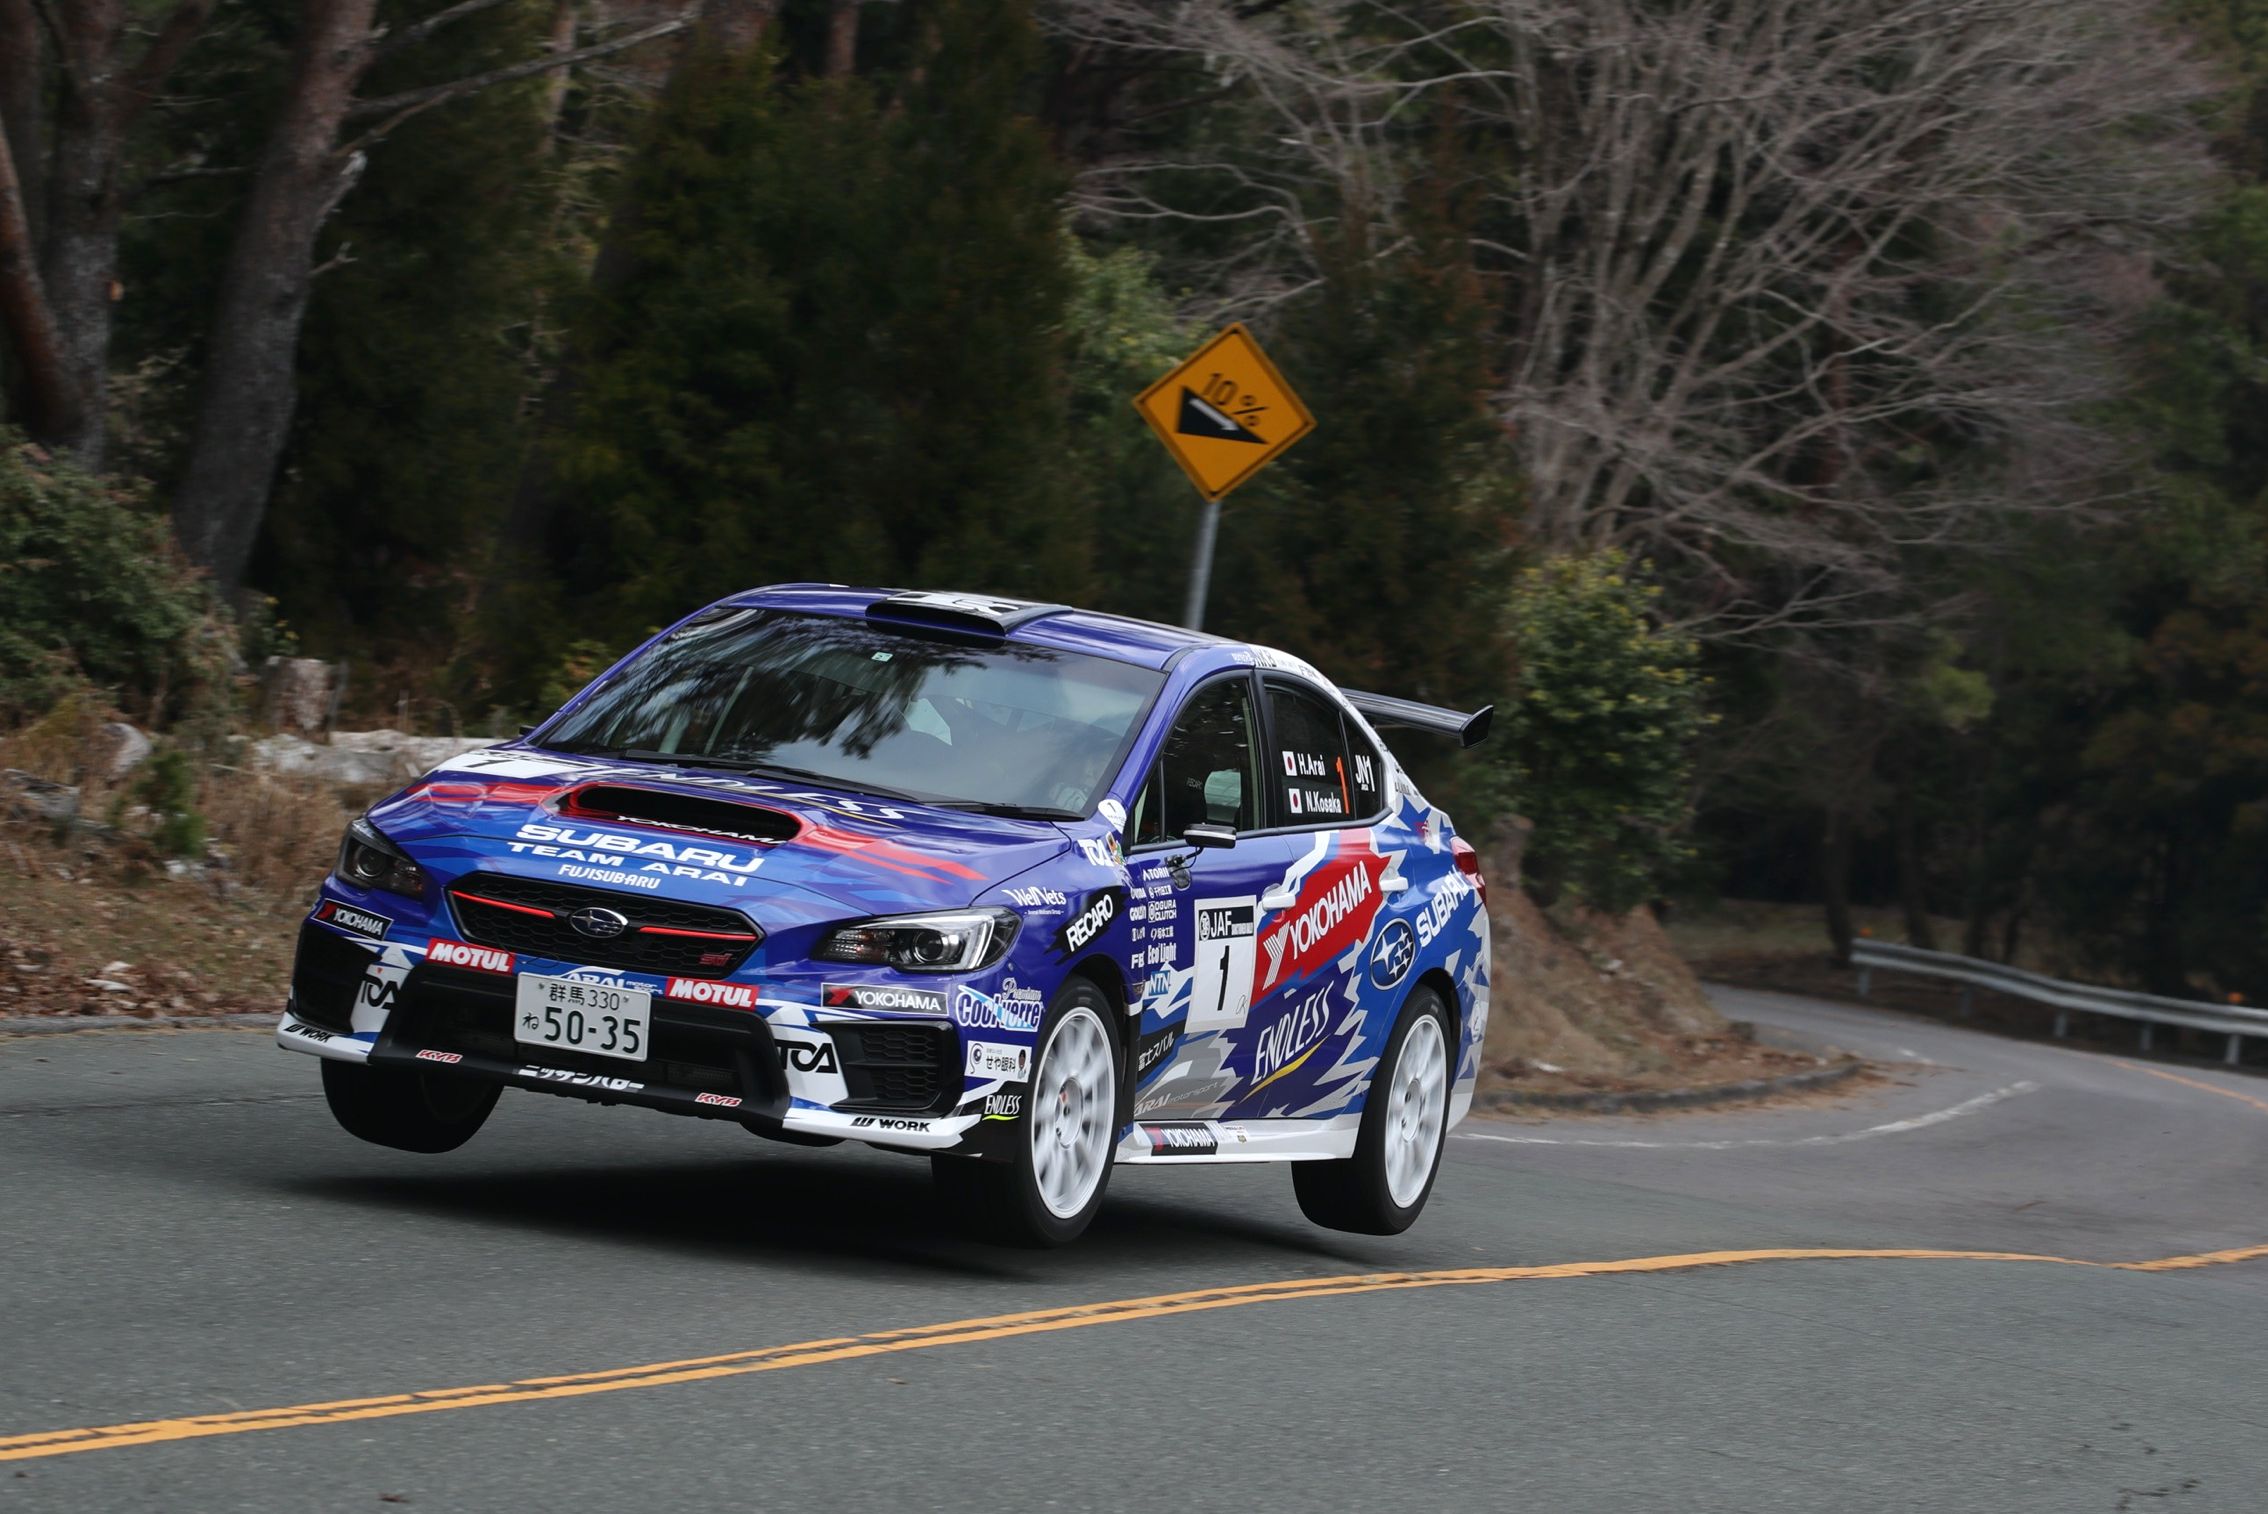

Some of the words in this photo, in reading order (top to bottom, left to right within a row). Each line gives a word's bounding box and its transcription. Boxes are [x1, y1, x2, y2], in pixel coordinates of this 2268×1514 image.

[1297, 752, 1326, 776] H.Arai
[1305, 790, 1343, 814] N.Kosaka
[516, 823, 765, 873] SUBARU
[507, 841, 625, 867] TEAM
[640, 862, 749, 887] ARAI
[558, 864, 661, 889] FUJISUBARU
[331, 907, 385, 935] YOKOHAMA
[1066, 894, 1114, 952] RECARO
[1210, 910, 1233, 938] JAF
[1289, 860, 1373, 960] YOKOHAMA
[428, 942, 511, 972] MOTUL
[1149, 973, 1170, 995] NTN
[1217, 944, 1231, 1011] 1
[669, 979, 753, 1008] MOTUL
[855, 990, 942, 1011] YOKOHAMA
[300, 1027, 335, 1044] WORK
[522, 1012, 539, 1030] ね
[544, 1006, 641, 1054] 50-35
[1249, 980, 1335, 1087] ENDLESS
[417, 1049, 463, 1064] KYB
[1138, 1031, 1176, 1072] 富士スバル
[695, 1092, 742, 1107] KYB
[984, 1095, 1022, 1115] ENDLESS
[878, 1118, 931, 1133] WORK
